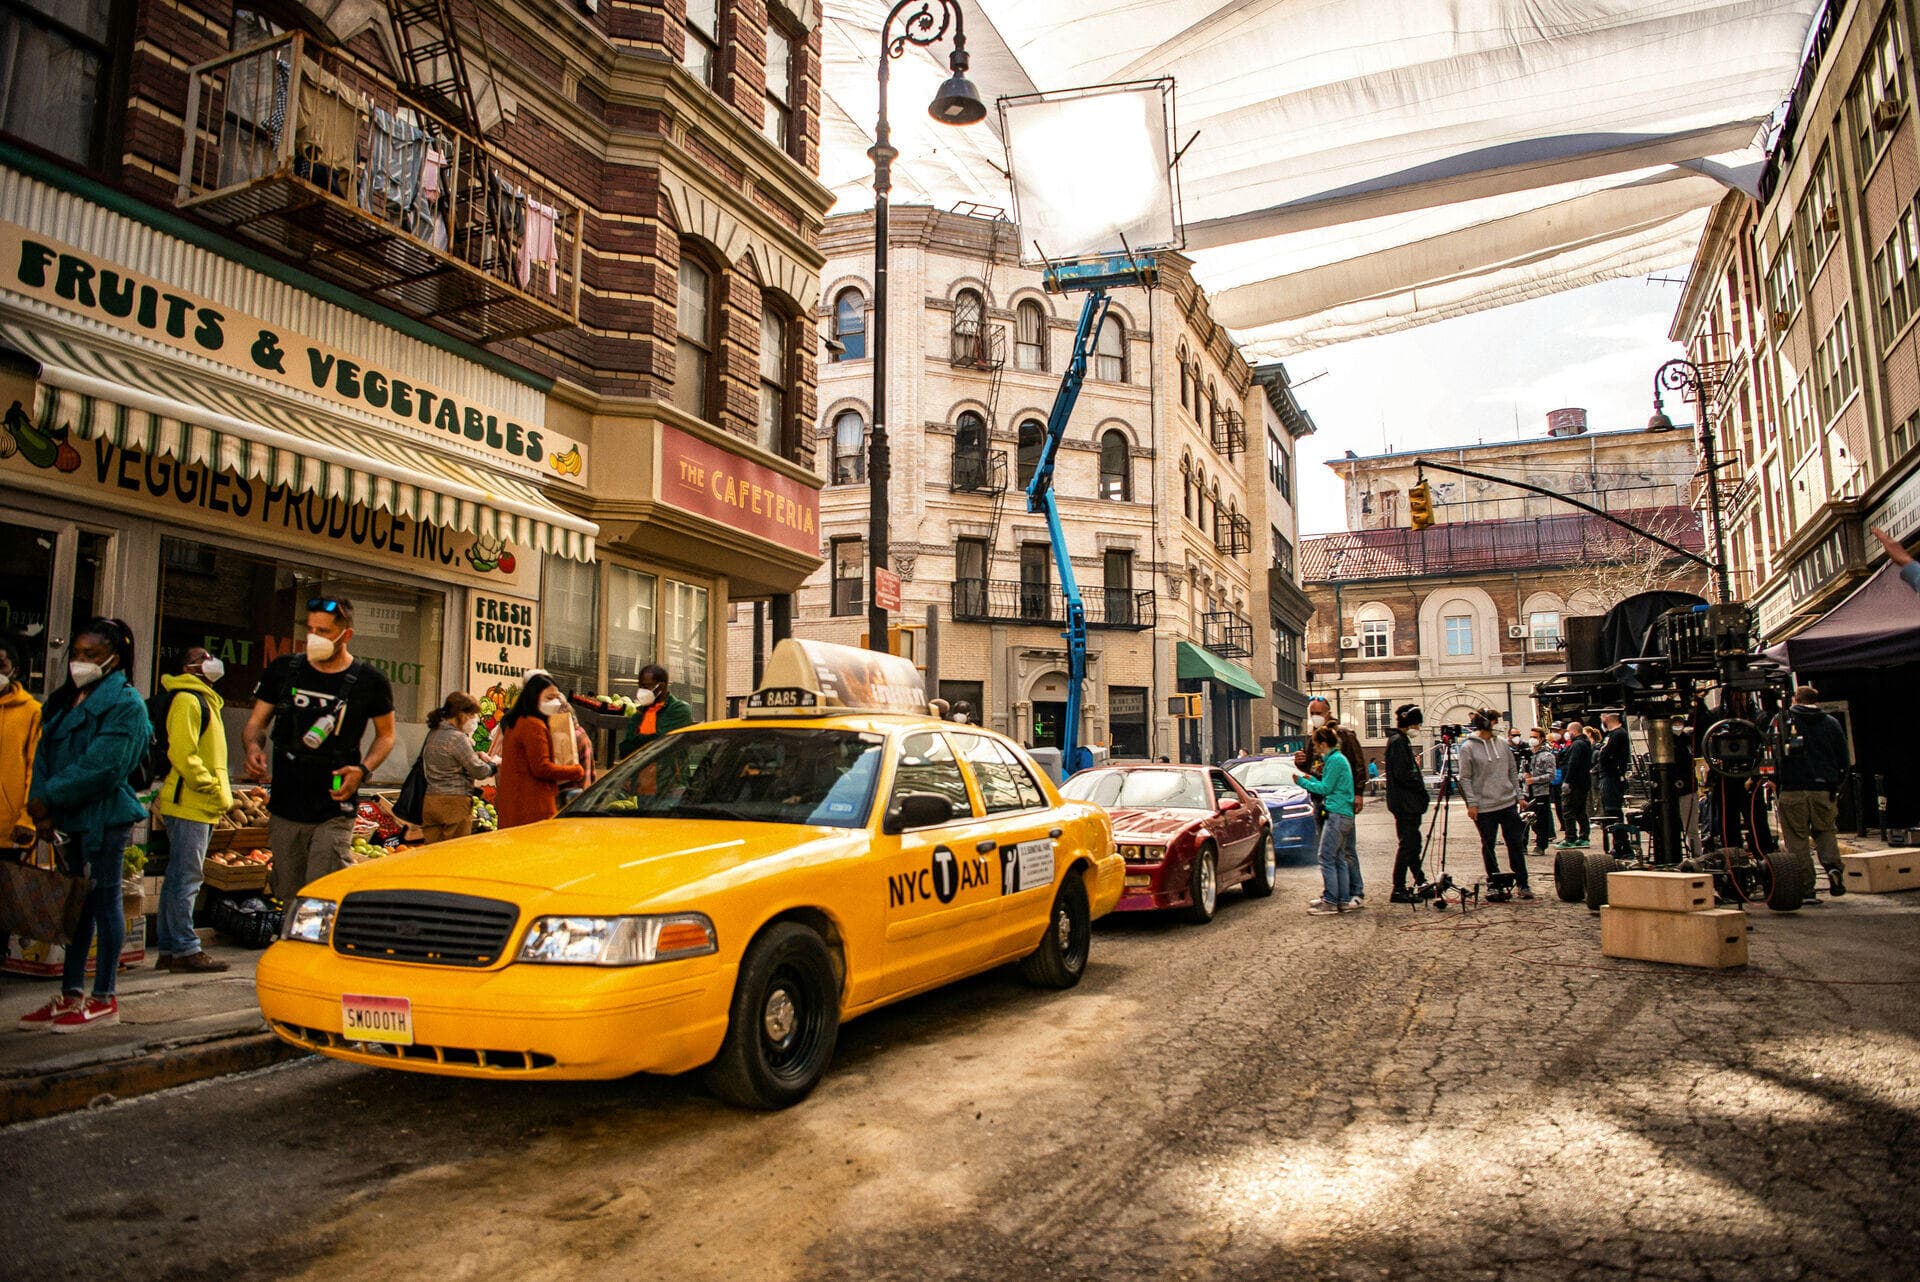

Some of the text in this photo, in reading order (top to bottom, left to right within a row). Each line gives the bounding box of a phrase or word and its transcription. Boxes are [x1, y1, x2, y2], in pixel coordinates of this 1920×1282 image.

[18, 240, 543, 463] FRUITS & VEGETABLES
[95, 437, 460, 566] VEGGIES PRODUCE INC.
[679, 460, 815, 536] THE CAFETERIA
[1789, 530, 1845, 601] CINEMA
[476, 597, 532, 627] FRESH
[204, 635, 254, 665] EAT
[476, 621, 532, 648] FRUITS
[499, 646, 509, 663] &
[475, 661, 530, 678] VEGETABLE
[888, 868, 931, 908] NYC
[934, 851, 990, 896] TAXI
